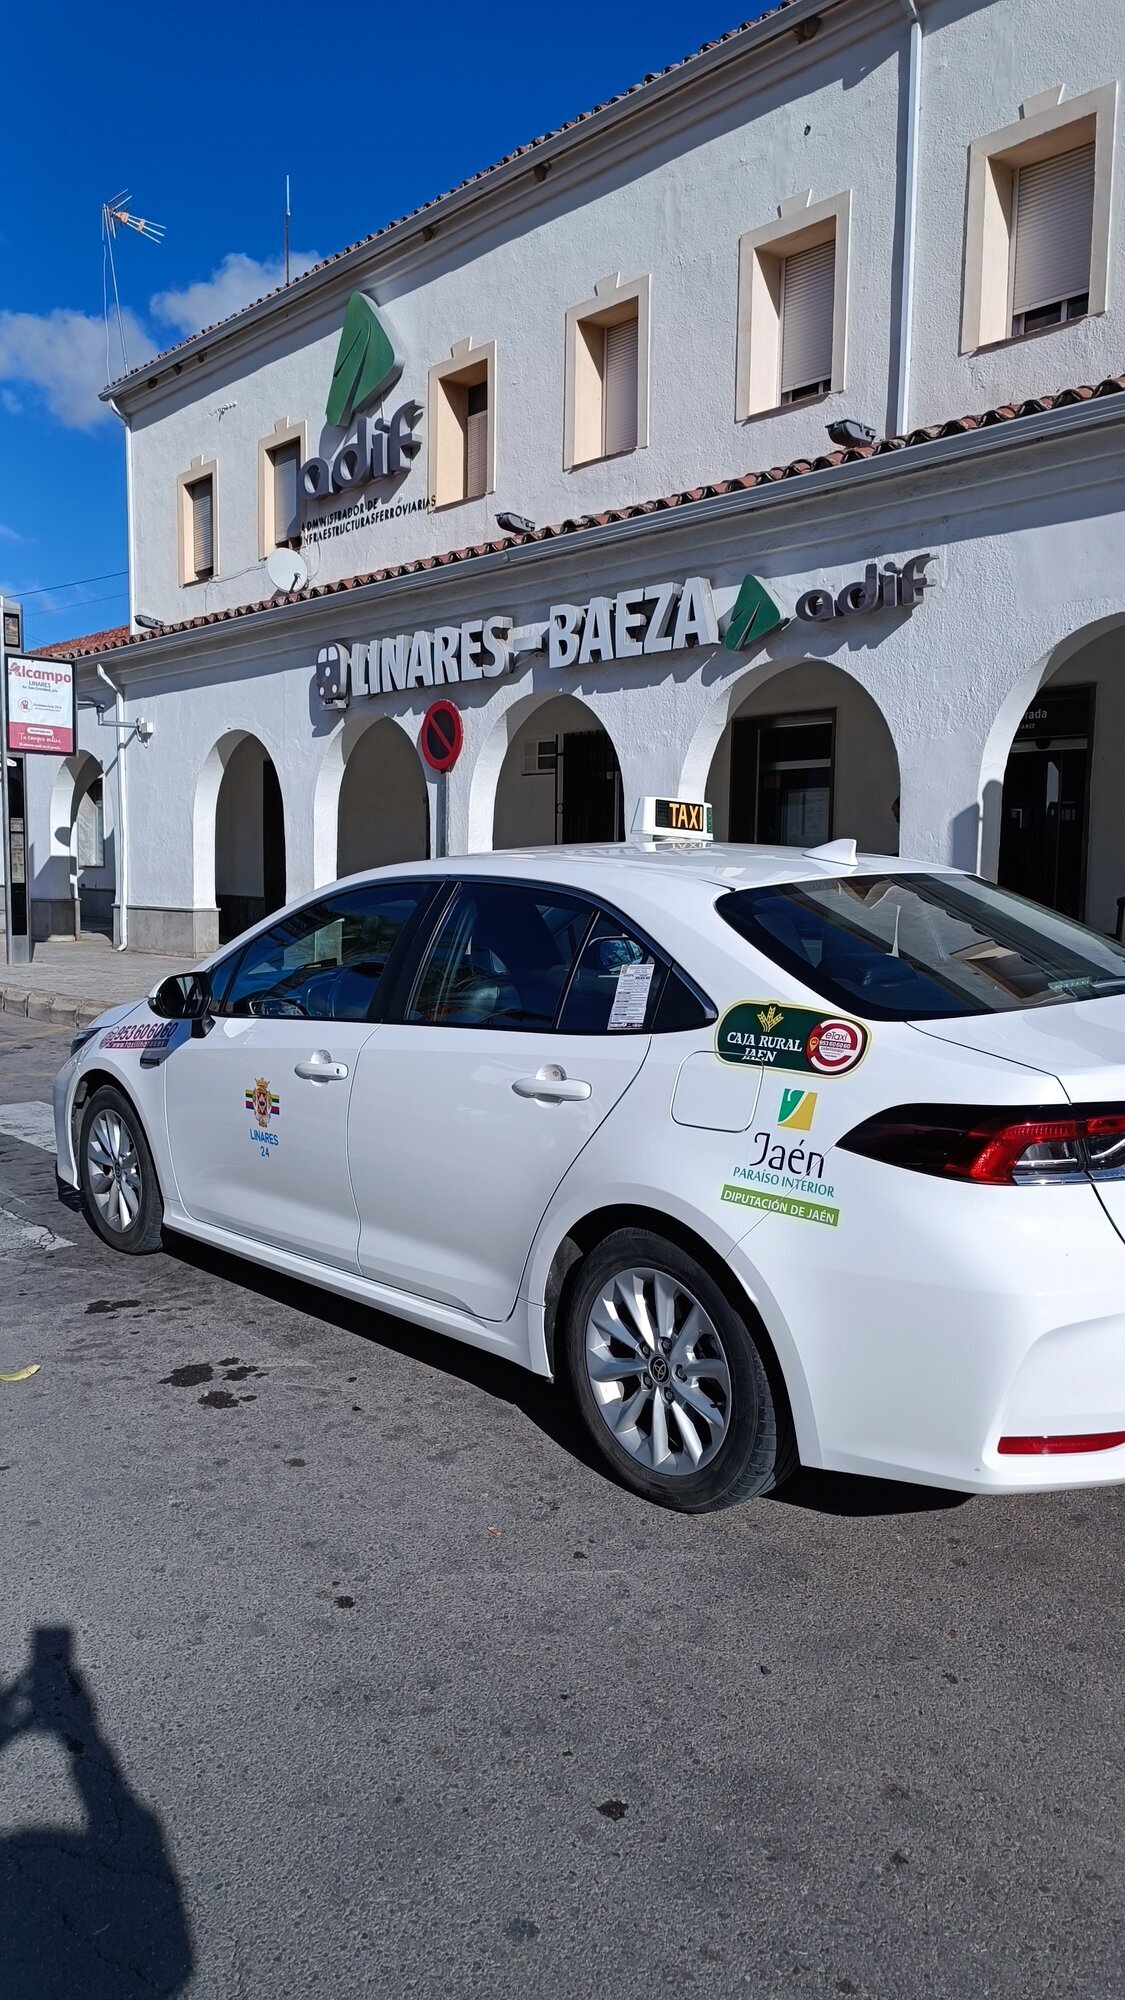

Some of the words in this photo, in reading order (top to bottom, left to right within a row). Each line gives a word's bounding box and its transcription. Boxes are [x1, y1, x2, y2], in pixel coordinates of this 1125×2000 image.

[299, 399, 424, 500] adif
[367, 498, 378, 513] DE
[795, 553, 938, 623] adif
[8, 662, 72, 684] Alcampo
[28, 680, 51, 688] LINARES
[1024, 708, 1047, 720] rada
[668, 802, 703, 830] TAXI
[727, 1031, 756, 1046] CAJA
[758, 1035, 802, 1051] RURAL
[825, 1031, 848, 1041] eTaxi
[249, 1128, 279, 1146] LINARES
[260, 1146, 270, 1158] 24
[749, 1132, 825, 1178] Jaén
[733, 1166, 779, 1185] PARAÍSO
[781, 1176, 835, 1198] INTERIOR
[724, 1189, 788, 1214] DIPUTACIÓN
[790, 1204, 805, 1217] DE
[806, 1208, 835, 1224] JAÉN
